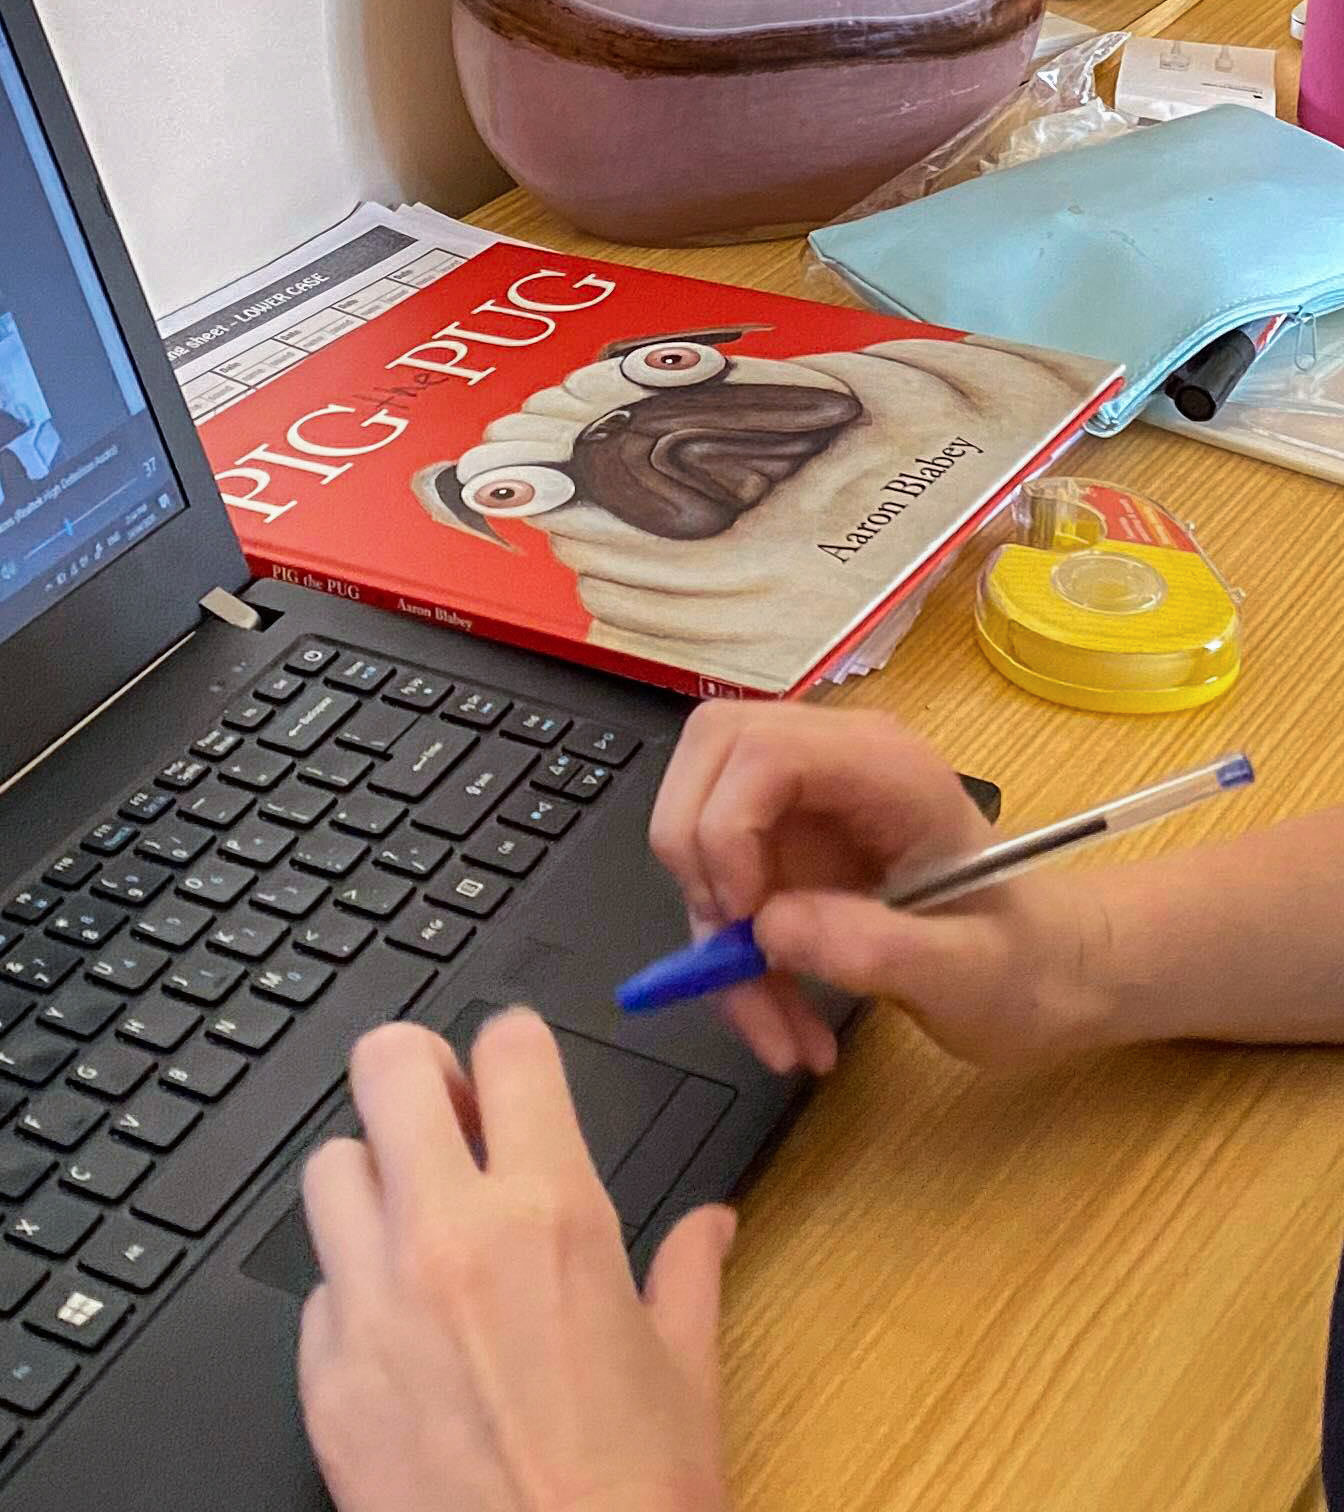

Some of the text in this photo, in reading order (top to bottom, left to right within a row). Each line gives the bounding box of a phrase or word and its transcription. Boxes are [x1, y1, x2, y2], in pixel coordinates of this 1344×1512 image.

[186, 324, 231, 349] sheet
[234, 292, 291, 324] LOWER
[285, 272, 330, 296] CASE
[214, 267, 616, 524] PIG the PUG
[143, 457, 156, 477] 37
[817, 435, 984, 564] Aaron Blabey
[271, 564, 360, 601] PIG the PUG
[397, 598, 473, 632] Aaron Blabey
